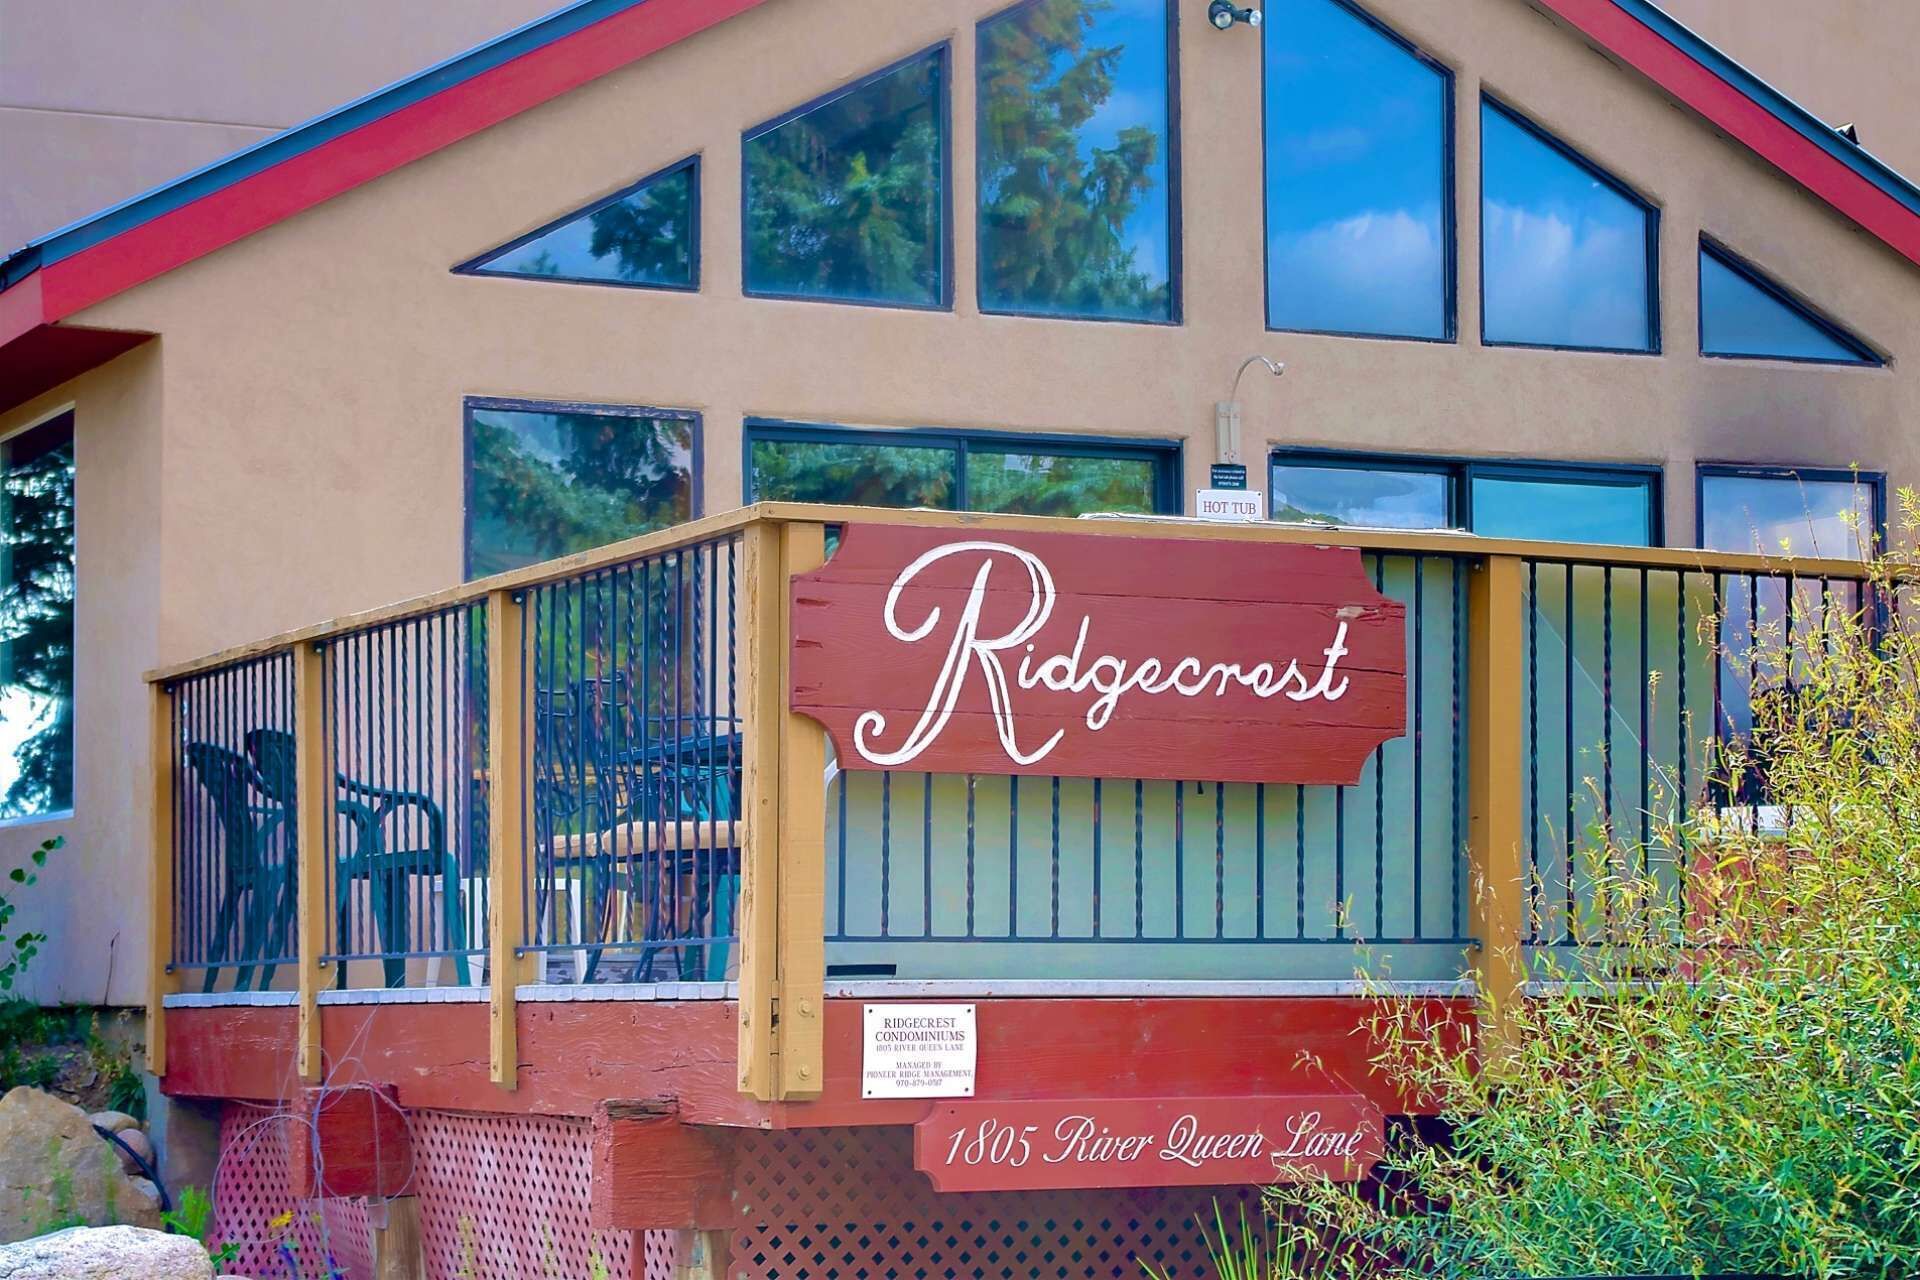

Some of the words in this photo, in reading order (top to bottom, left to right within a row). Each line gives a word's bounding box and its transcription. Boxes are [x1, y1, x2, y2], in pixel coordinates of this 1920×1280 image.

[1203, 501, 1228, 513] HOT
[1232, 502, 1256, 514] TUB
[853, 541, 1350, 766] Ridgecrest
[884, 1017, 956, 1029] RIDGECREST
[875, 1030, 966, 1042] CONDOMINIUMS
[876, 1044, 892, 1052] 1805
[894, 1044, 916, 1052] RIVER
[919, 1043, 943, 1052] QUEEN
[944, 1043, 964, 1051] LANE
[896, 1061, 932, 1069] MANAGED
[899, 1070, 921, 1078] RIDGE
[945, 1117, 1039, 1167] 1805
[1042, 1114, 1154, 1164] River
[1159, 1114, 1264, 1167] Queen
[1275, 1111, 1363, 1157] Lane
